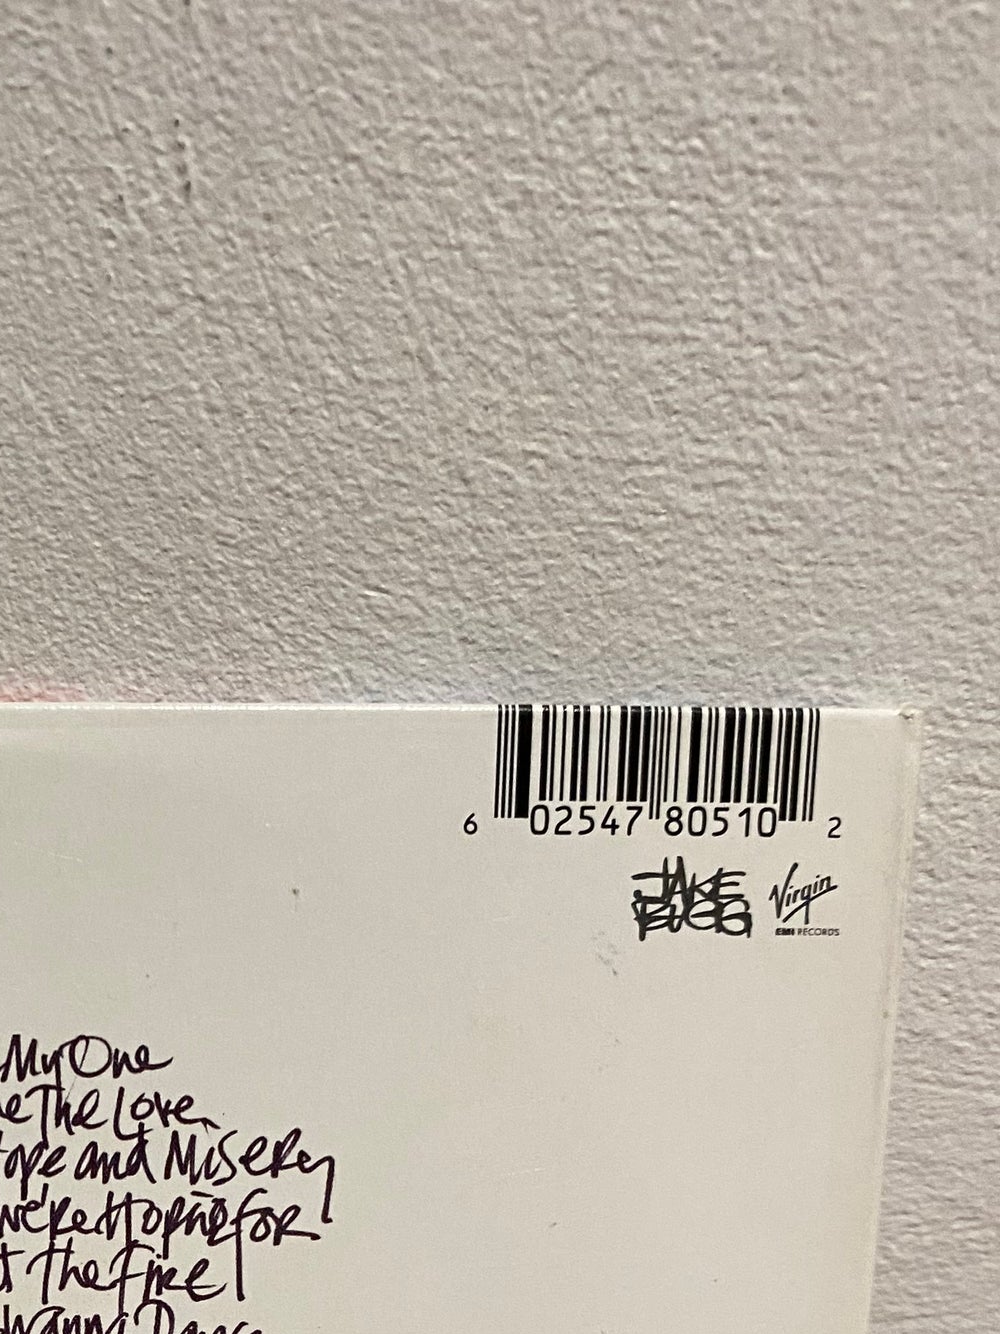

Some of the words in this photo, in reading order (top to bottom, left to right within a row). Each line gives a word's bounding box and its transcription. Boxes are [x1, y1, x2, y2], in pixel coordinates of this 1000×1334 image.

[463, 813, 478, 835] 6
[529, 804, 644, 836] 02547
[663, 806, 778, 838] 80510
[827, 816, 842, 838] 2
[631, 856, 746, 900] JAKE
[768, 862, 838, 925] Virgin
[797, 928, 840, 937] RECORDS
[0, 1034, 68, 1086] My
[67, 1035, 173, 1079] One
[25, 1084, 109, 1149] The
[74, 1121, 157, 1184] and
